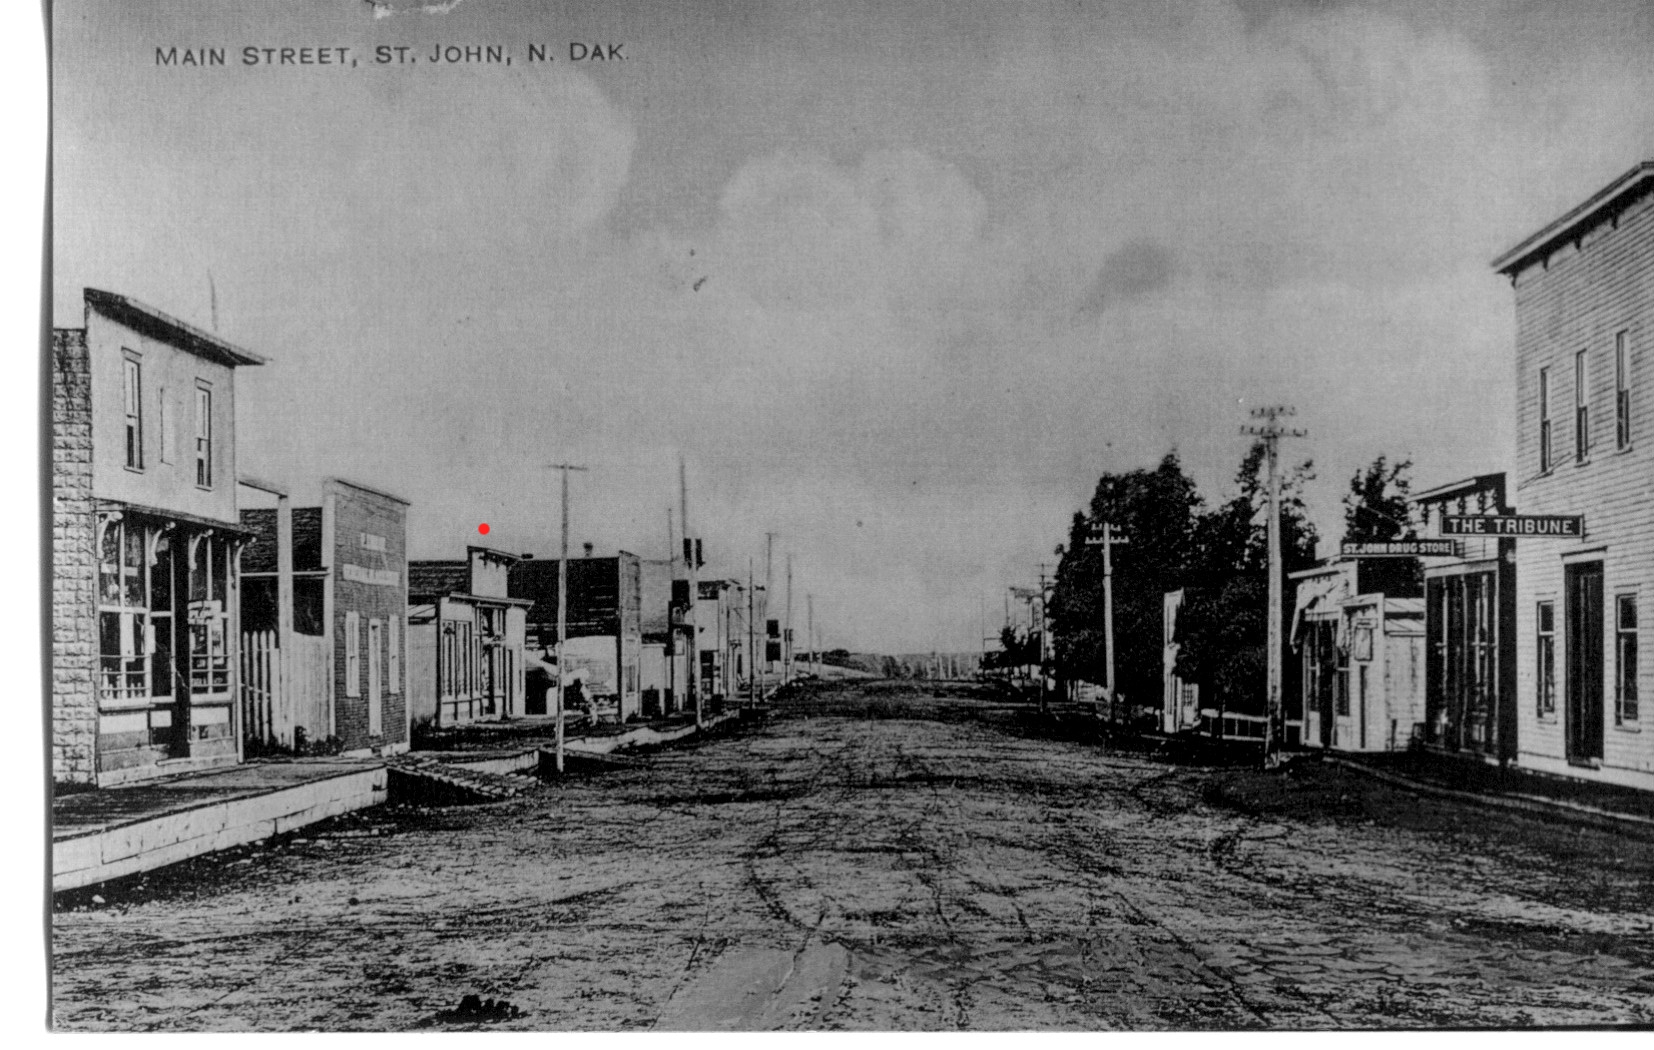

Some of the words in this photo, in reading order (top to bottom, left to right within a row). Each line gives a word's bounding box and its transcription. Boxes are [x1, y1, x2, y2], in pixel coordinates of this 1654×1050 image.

[1449, 518, 1486, 534] THE
[1494, 518, 1574, 535] TRIBUNE
[1389, 542, 1418, 554] DRUG
[1420, 542, 1450, 554] STORE
